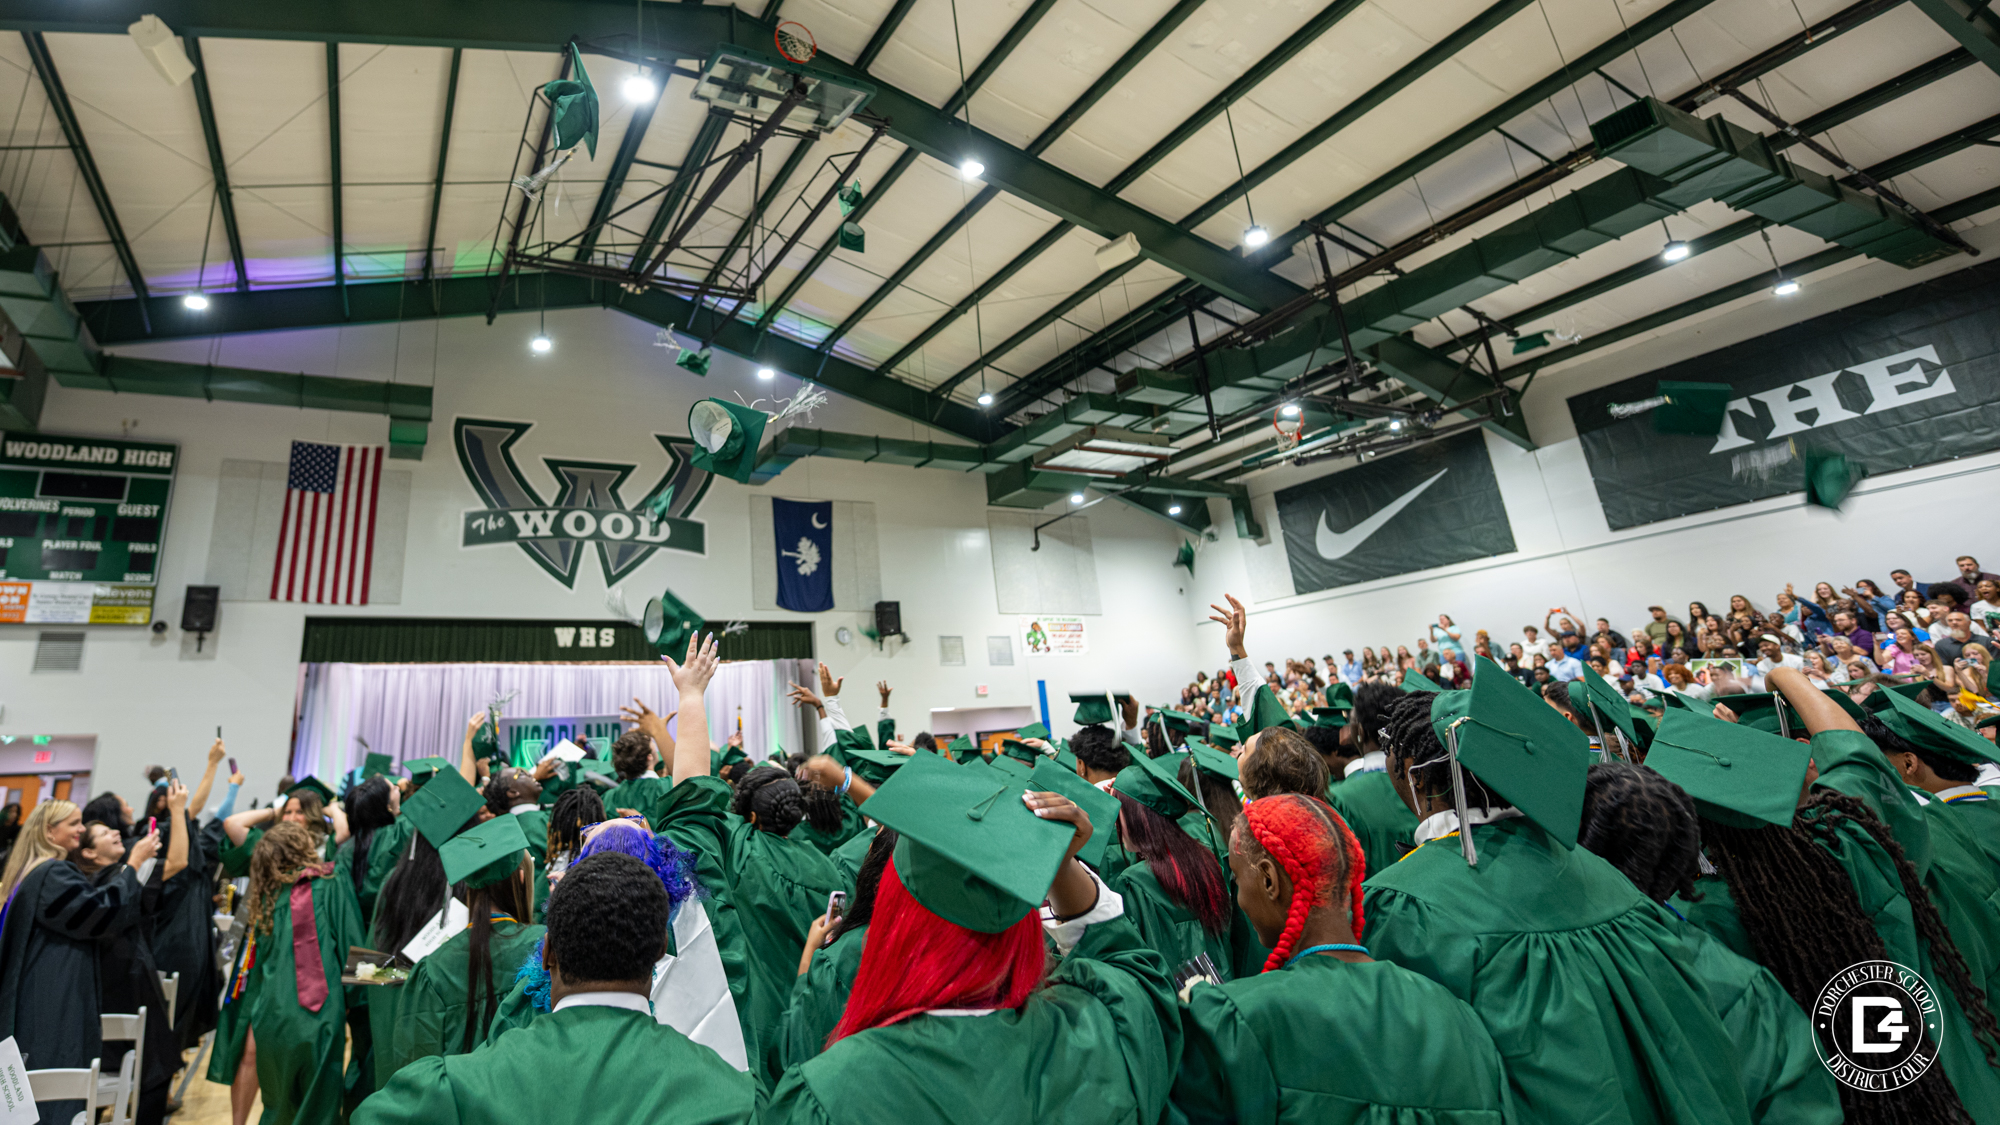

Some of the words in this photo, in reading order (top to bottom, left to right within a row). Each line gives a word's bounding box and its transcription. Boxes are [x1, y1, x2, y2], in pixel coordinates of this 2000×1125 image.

[1709, 344, 1957, 455] THE
[5, 440, 119, 464] WOODLAND
[123, 450, 174, 468] HIGH
[0, 496, 59, 512] OLVERINES
[62, 506, 95, 518] PERIOD
[117, 503, 160, 517] GUEST
[472, 514, 506, 535] The
[508, 509, 671, 543] WOOD
[42, 539, 78, 551] PLAYER
[80, 540, 103, 552] FOUL
[128, 542, 157, 553] FOULS
[49, 571, 83, 580] MATCH
[123, 572, 152, 582] SCORE
[554, 627, 615, 648] WHS
[8, 1063, 24, 1102] WOODLAND
[2, 1084, 15, 1113] SCHOOL
